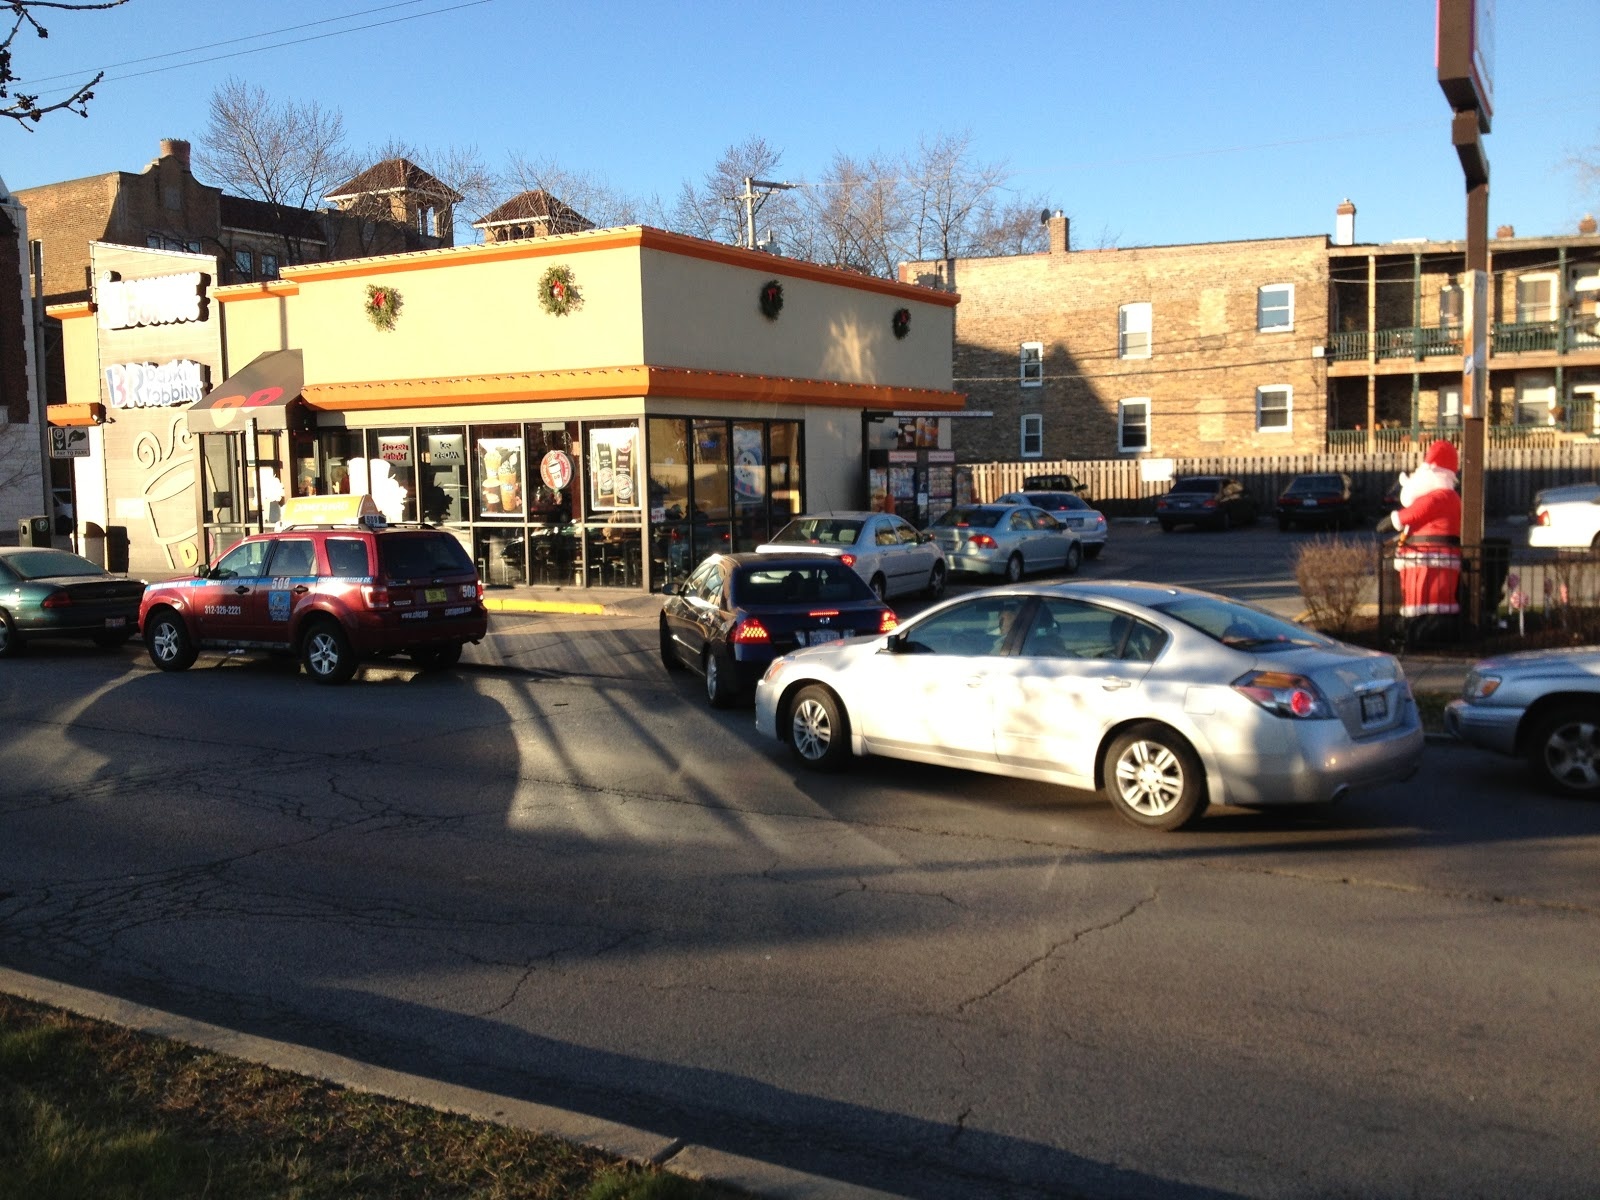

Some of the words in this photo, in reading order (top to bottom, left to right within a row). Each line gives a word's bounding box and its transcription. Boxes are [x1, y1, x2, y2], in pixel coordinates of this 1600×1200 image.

[382, 443, 409, 451] frozen
[439, 441, 452, 449] ice
[434, 451, 460, 459] cream
[271, 577, 291, 590] 509
[462, 585, 477, 598] 509
[204, 605, 241, 615] 312-326-2221
